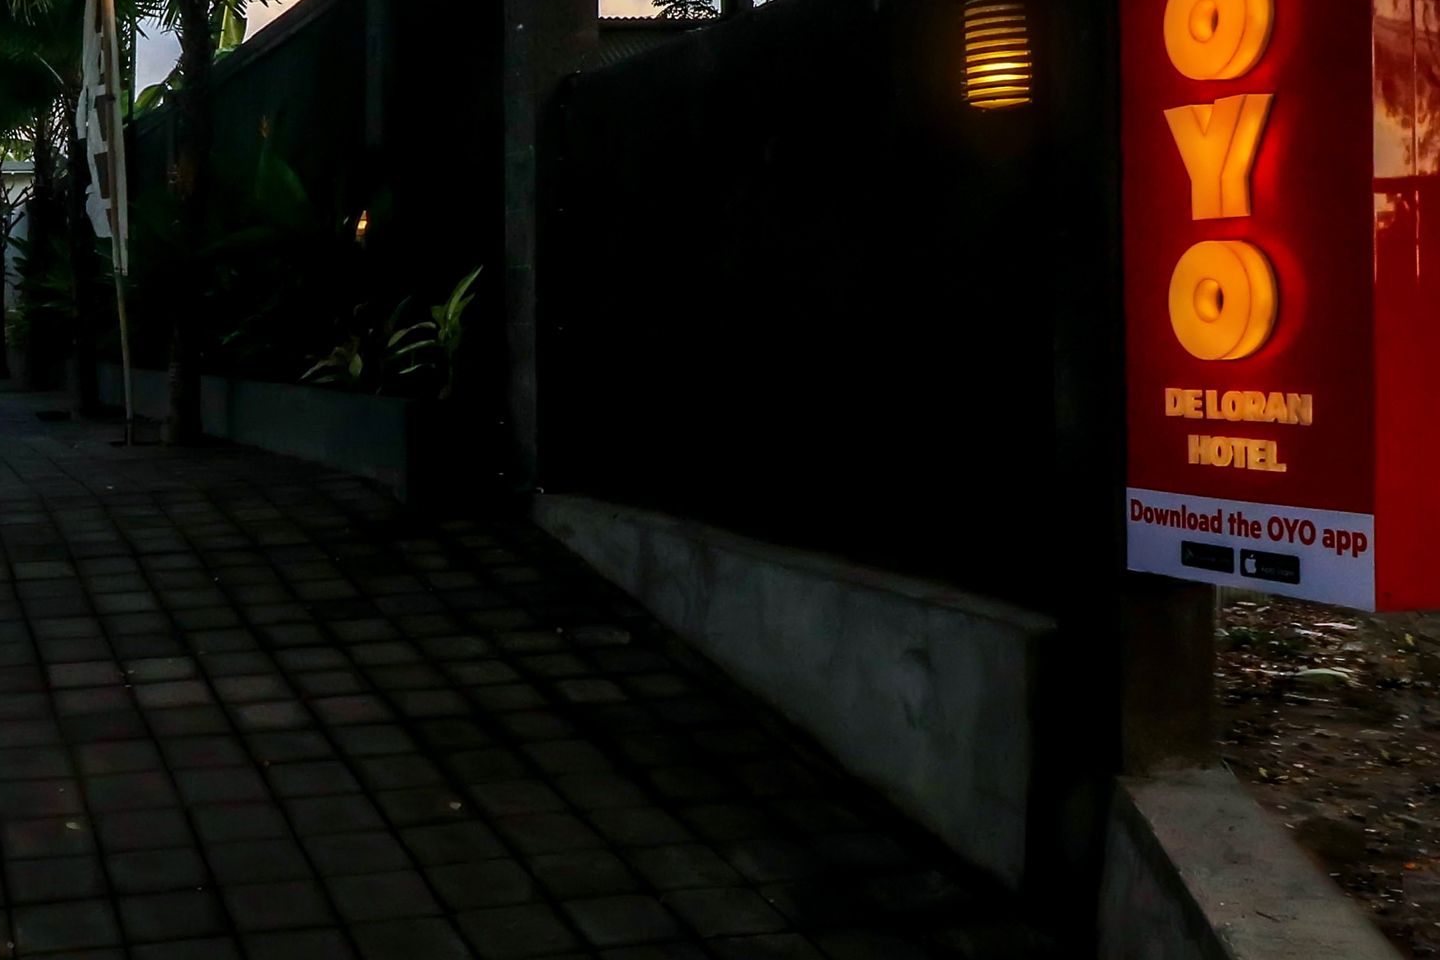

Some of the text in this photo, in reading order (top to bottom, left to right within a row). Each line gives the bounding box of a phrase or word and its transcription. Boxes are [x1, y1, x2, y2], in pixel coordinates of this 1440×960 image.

[1164, 387, 1313, 426] DE LORAN
[1187, 434, 1287, 472] HOTEL
[1130, 498, 1368, 558] Download the OYO app
